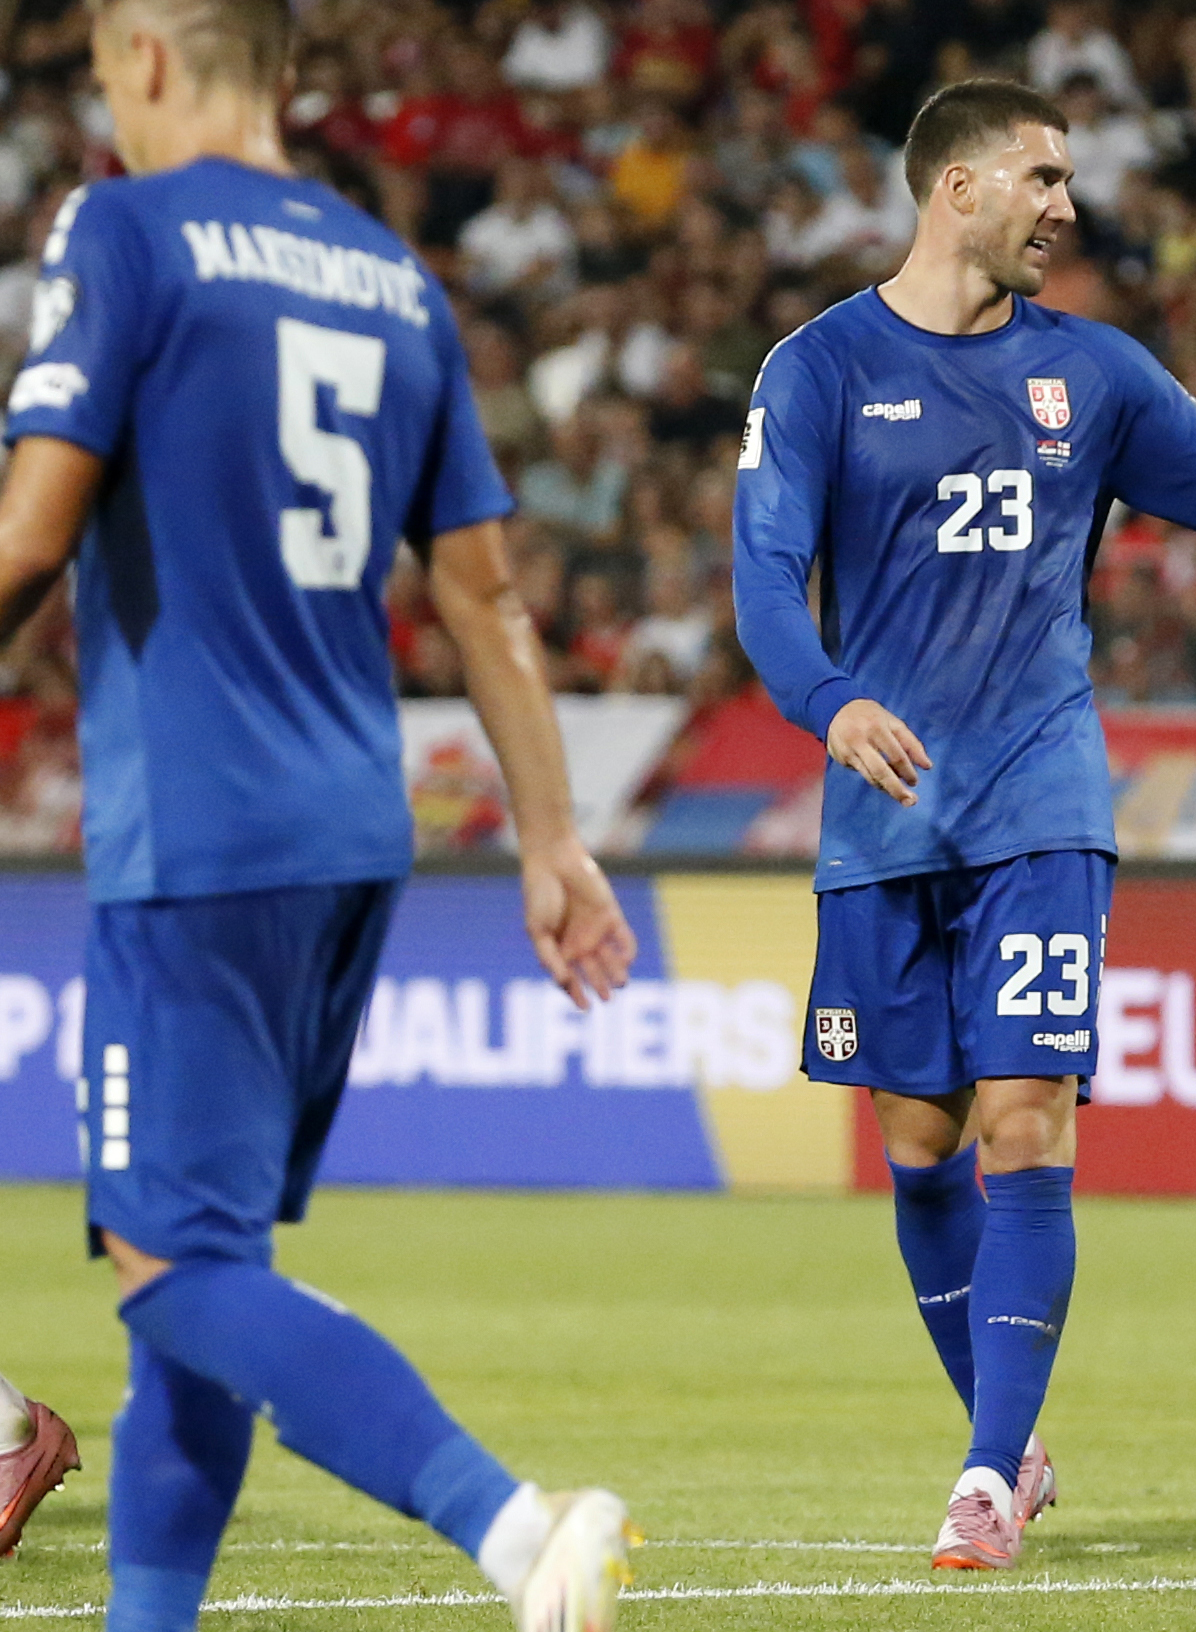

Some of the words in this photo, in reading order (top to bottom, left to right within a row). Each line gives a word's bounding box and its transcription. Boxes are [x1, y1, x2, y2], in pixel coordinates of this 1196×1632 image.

[862, 399, 921, 420] capelli
[276, 316, 387, 591] 5
[937, 469, 1033, 553] 23
[997, 933, 1089, 1016] 23
[347, 975, 797, 1092] UALIFIERS
[1033, 1030, 1090, 1049] capelli
